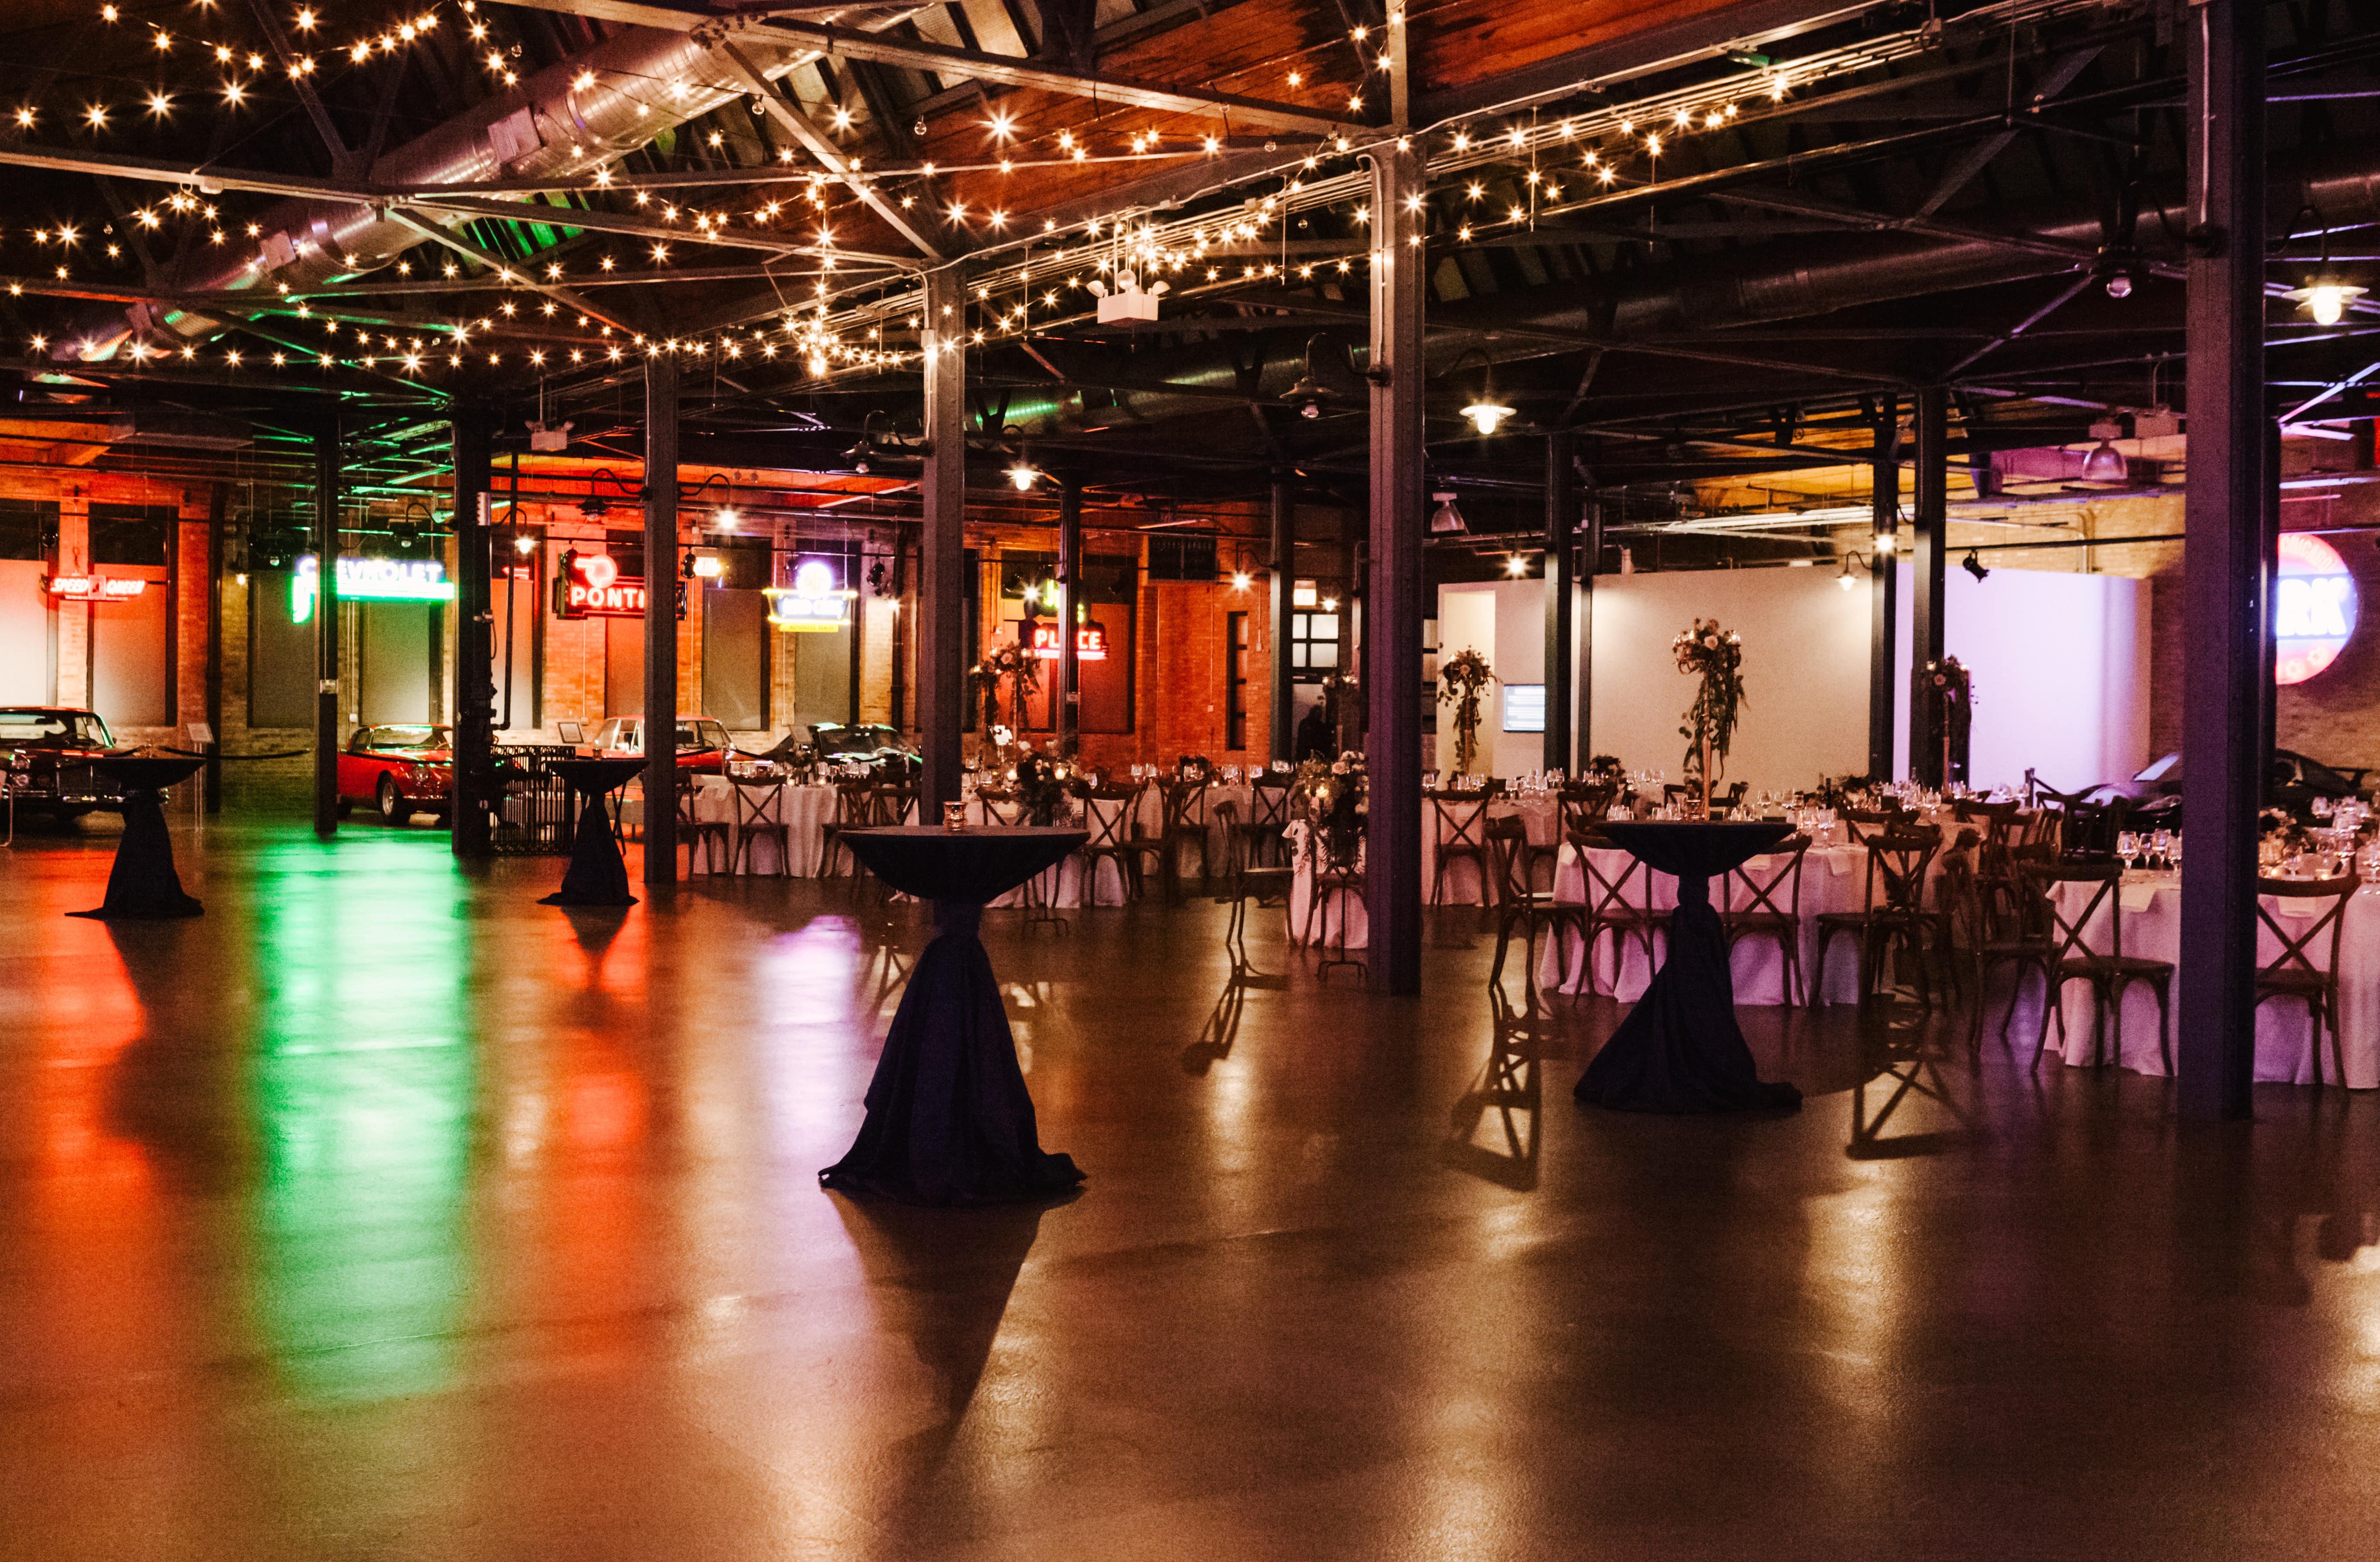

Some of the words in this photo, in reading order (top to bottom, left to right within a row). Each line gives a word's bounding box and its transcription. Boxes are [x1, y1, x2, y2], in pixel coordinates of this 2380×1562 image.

[299, 557, 442, 583] CEVROLET
[50, 579, 88, 592] SPEED
[107, 580, 145, 594] QUEEN
[571, 586, 645, 608] PONTI
[2277, 578, 2348, 636] RK
[1035, 629, 1101, 649] PLCE
